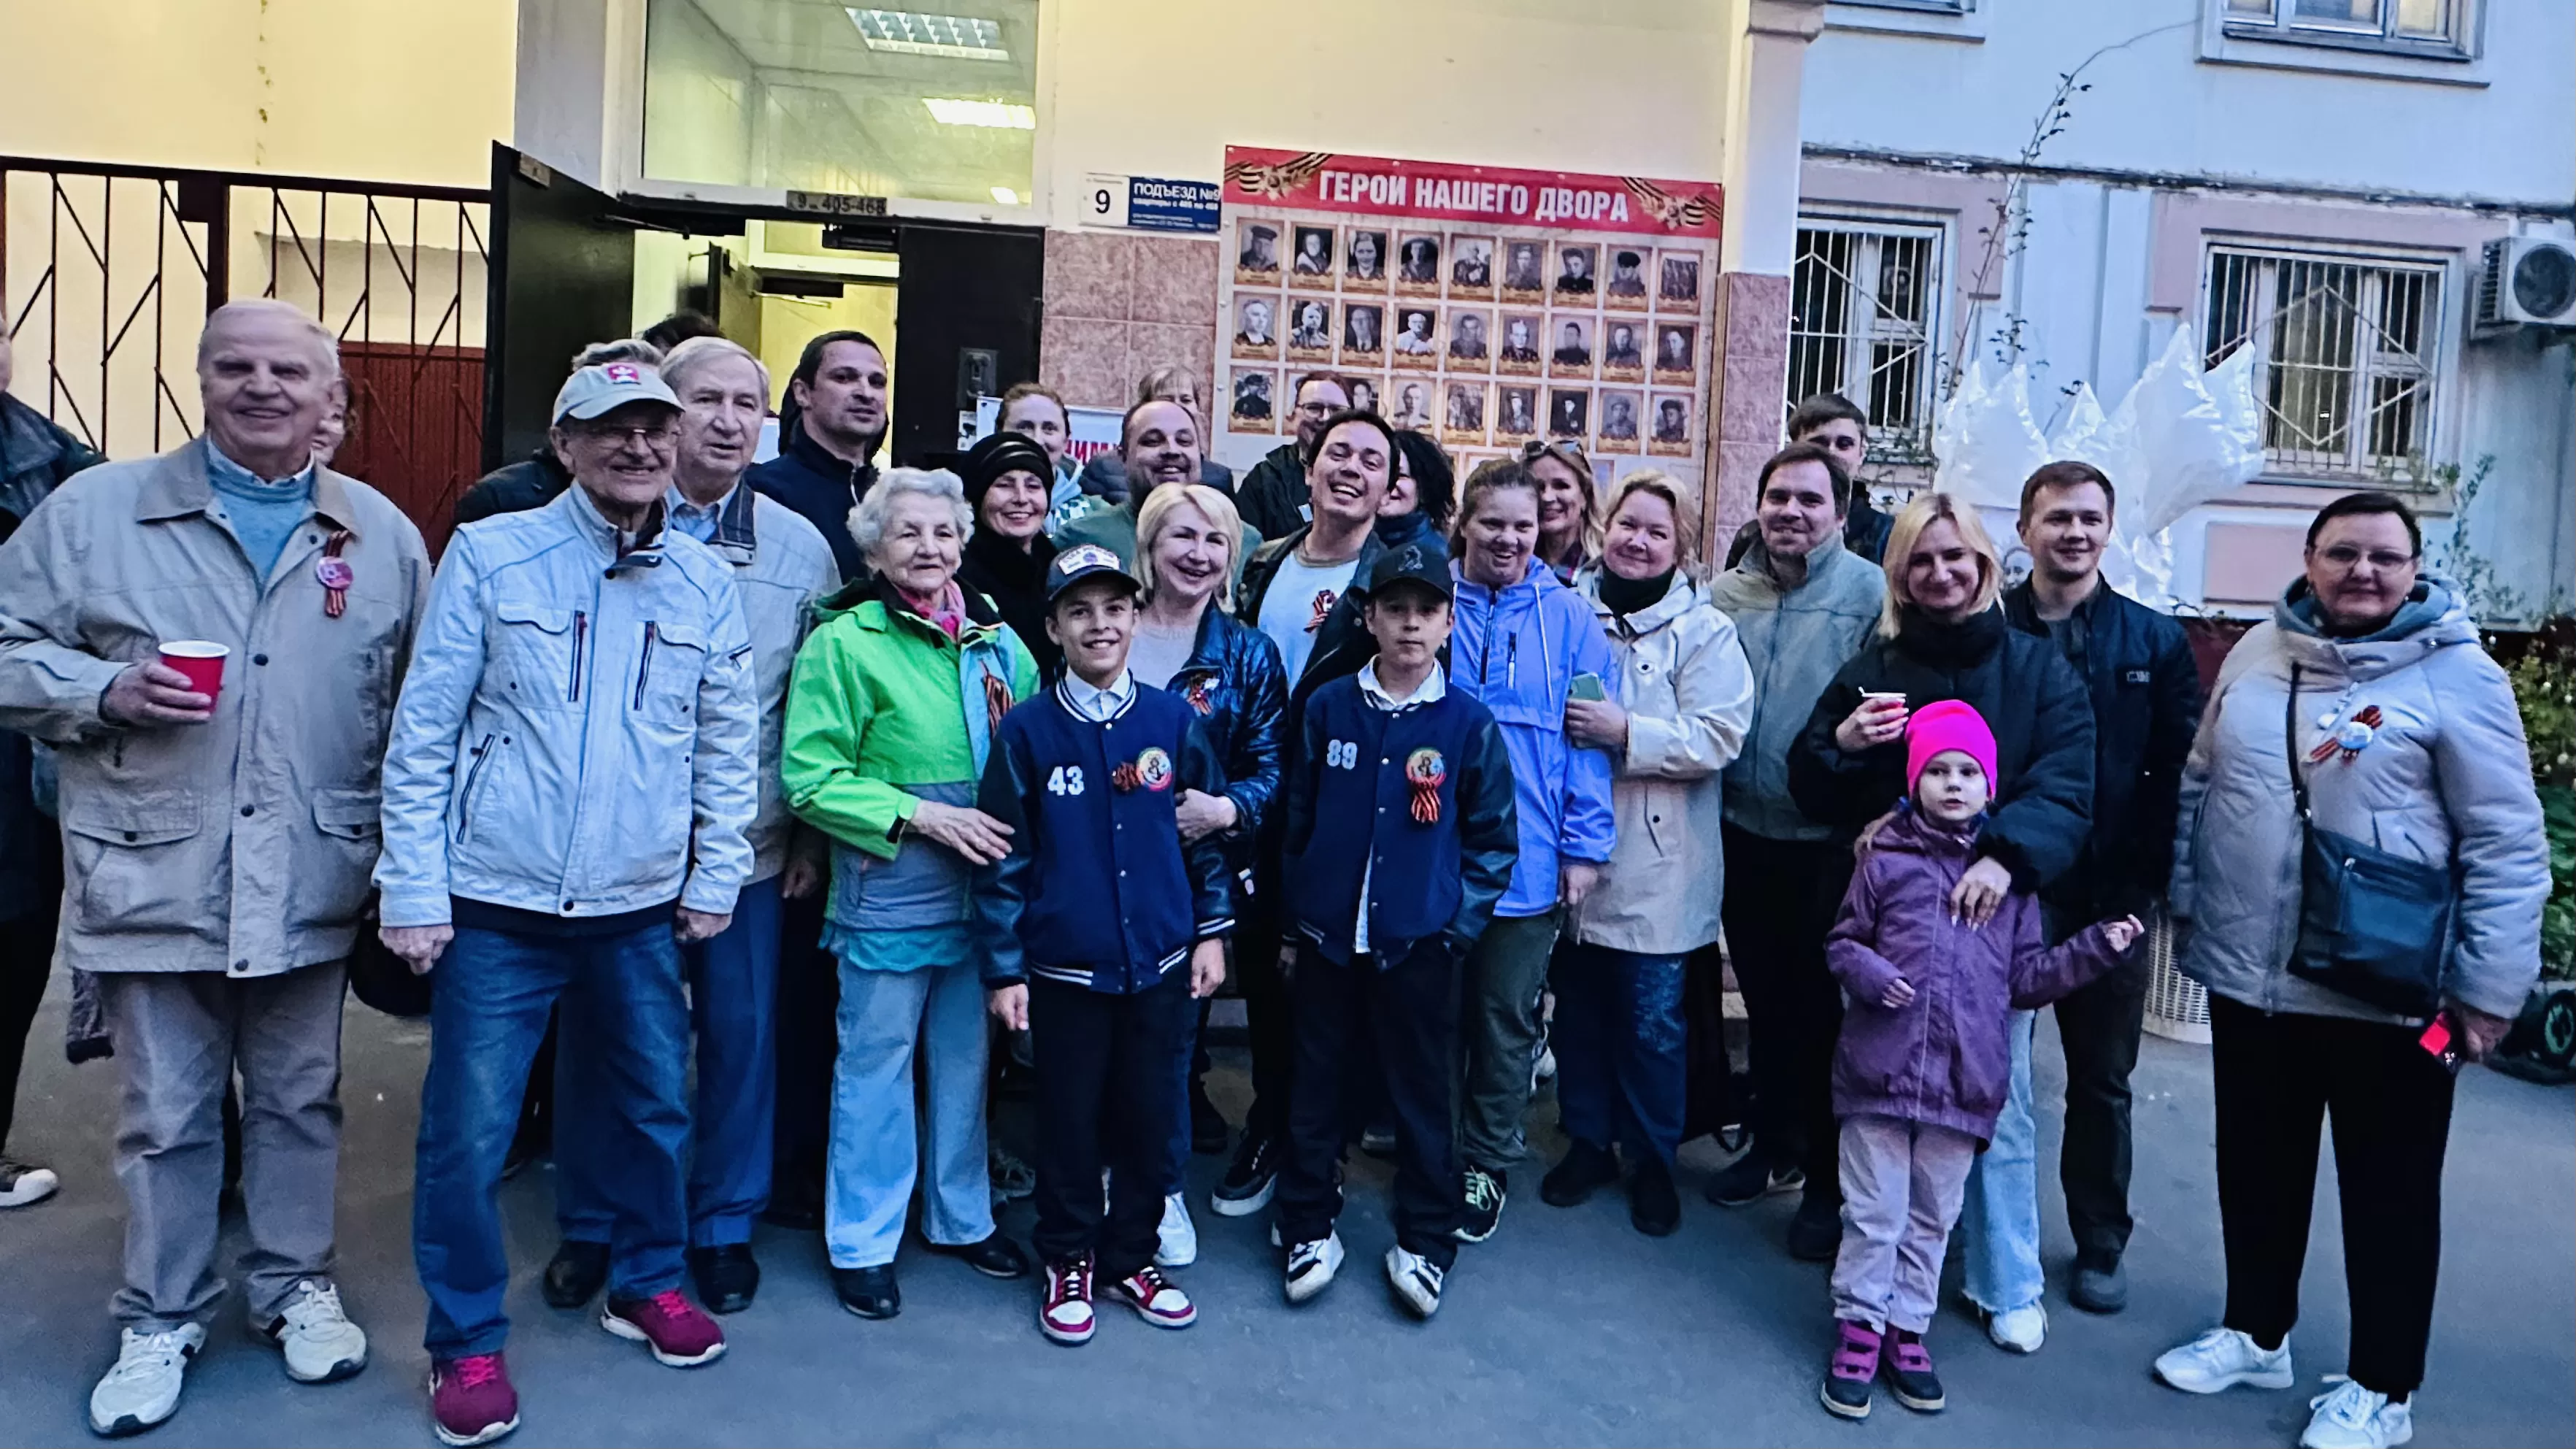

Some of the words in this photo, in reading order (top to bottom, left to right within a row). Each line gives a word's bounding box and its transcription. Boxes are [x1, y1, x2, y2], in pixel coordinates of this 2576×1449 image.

[822, 193, 887, 215] 405-468
[1095, 189, 1110, 214] 9
[1134, 182, 1196, 201] ПОДЪЕЗД
[1319, 170, 1406, 207] ГЕРОИ
[1415, 177, 1529, 215] НАШЕГО
[1535, 187, 1629, 222] ДВОРА
[1326, 739, 1358, 770] 89
[1047, 766, 1085, 796] 43
